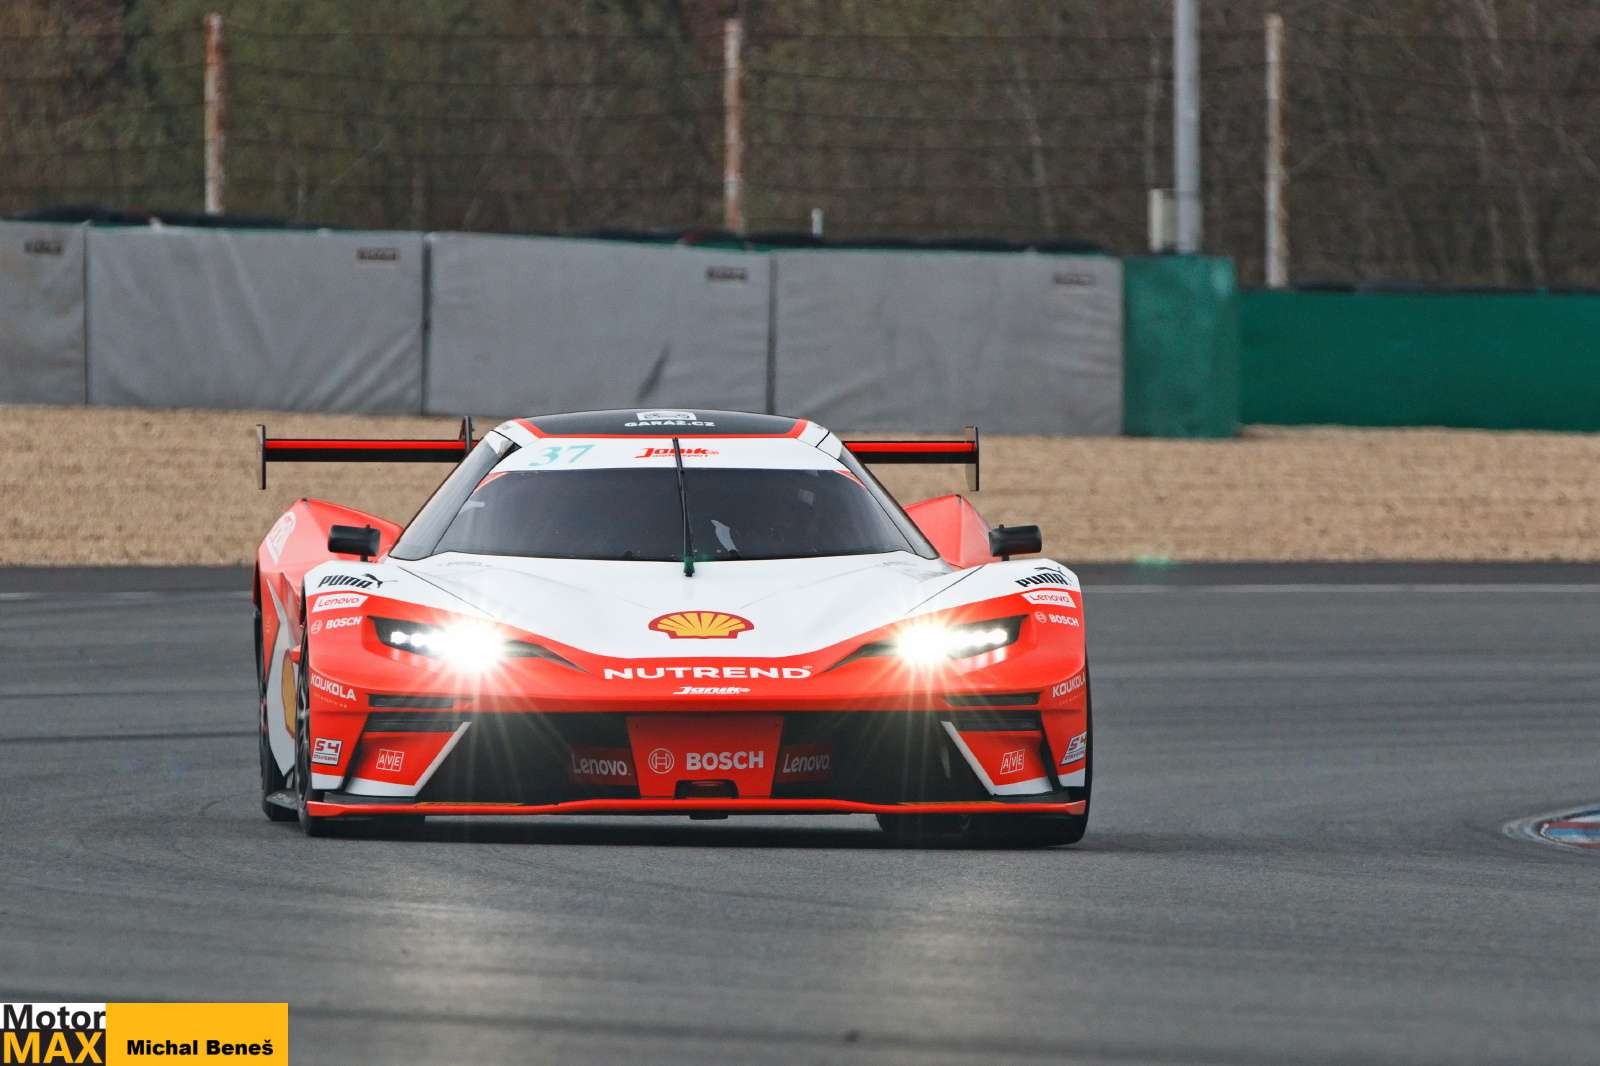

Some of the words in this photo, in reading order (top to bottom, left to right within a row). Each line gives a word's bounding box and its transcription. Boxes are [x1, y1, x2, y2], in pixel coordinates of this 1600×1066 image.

[528, 444, 595, 467] 37
[318, 597, 360, 607] Lenovo
[325, 616, 362, 630] BOSCH
[1048, 613, 1080, 627] BOSCH
[603, 666, 811, 680] NUTREND
[310, 672, 357, 702] KOUKOLA
[571, 754, 628, 776] Lenovo
[686, 751, 764, 770] BOSCH
[783, 753, 831, 774] Lenovo
